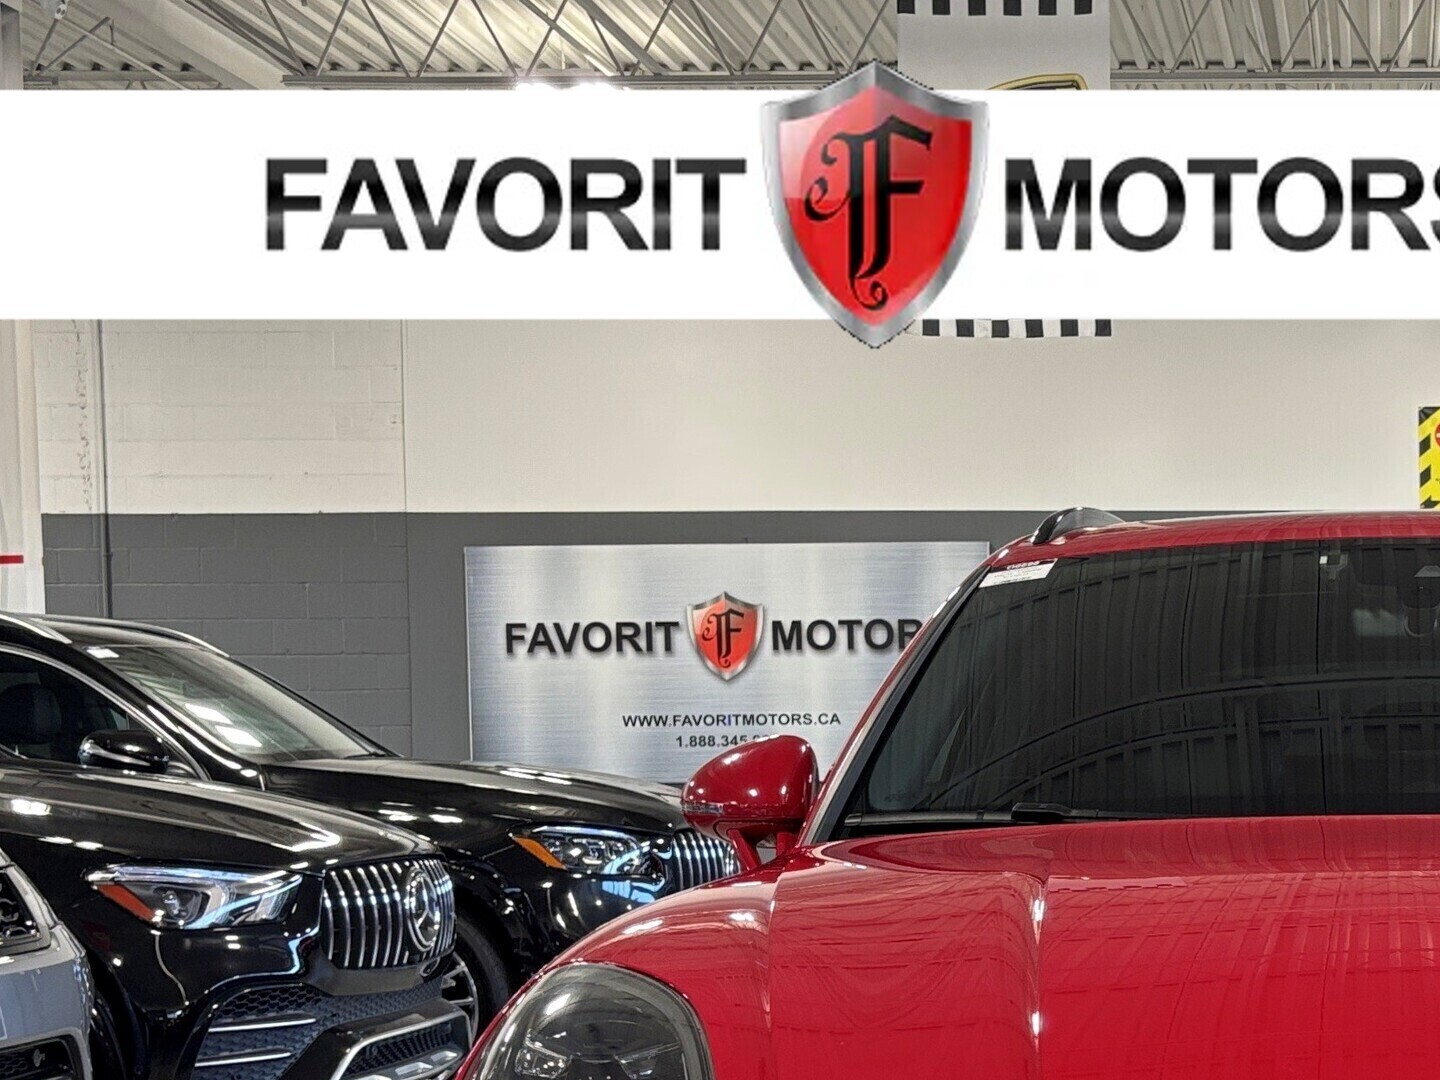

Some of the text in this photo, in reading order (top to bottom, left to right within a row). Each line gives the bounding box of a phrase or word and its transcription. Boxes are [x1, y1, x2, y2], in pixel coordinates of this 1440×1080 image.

[505, 620, 680, 655] FAVORIT
[771, 618, 923, 652] MOTOR
[622, 712, 841, 728] WWW.FAVORITMOTORS.CA
